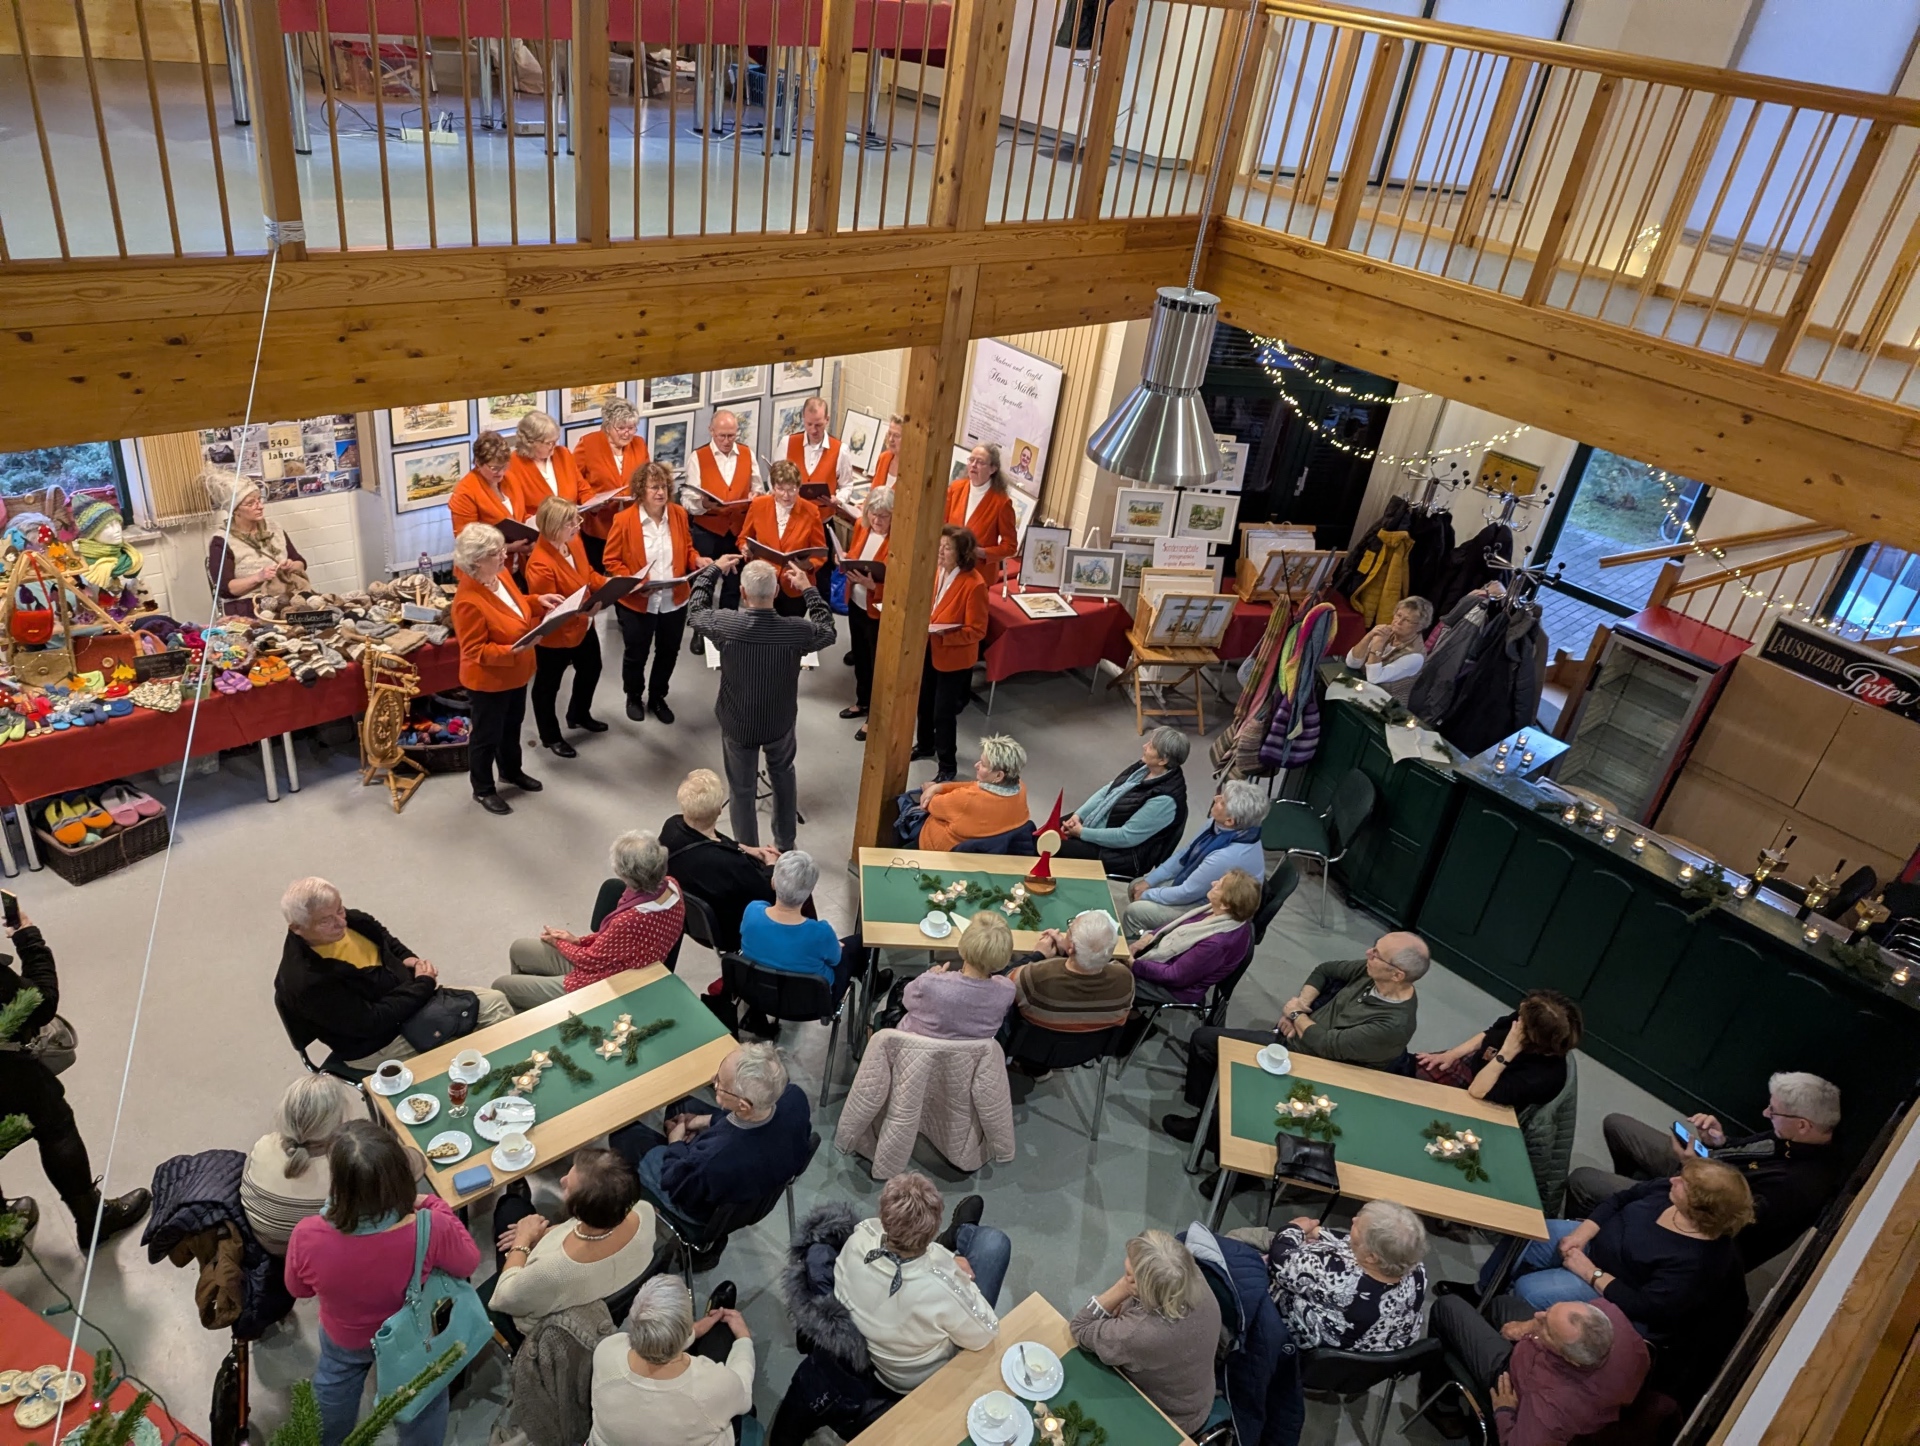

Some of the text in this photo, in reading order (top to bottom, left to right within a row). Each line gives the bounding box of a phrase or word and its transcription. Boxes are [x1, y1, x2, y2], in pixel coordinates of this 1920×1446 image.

[988, 367, 1039, 399] Hans Müller
[1025, 368, 1042, 381] Grafik
[270, 439, 289, 448] 540
[1767, 627, 1920, 706] LAUSITZER Porter
